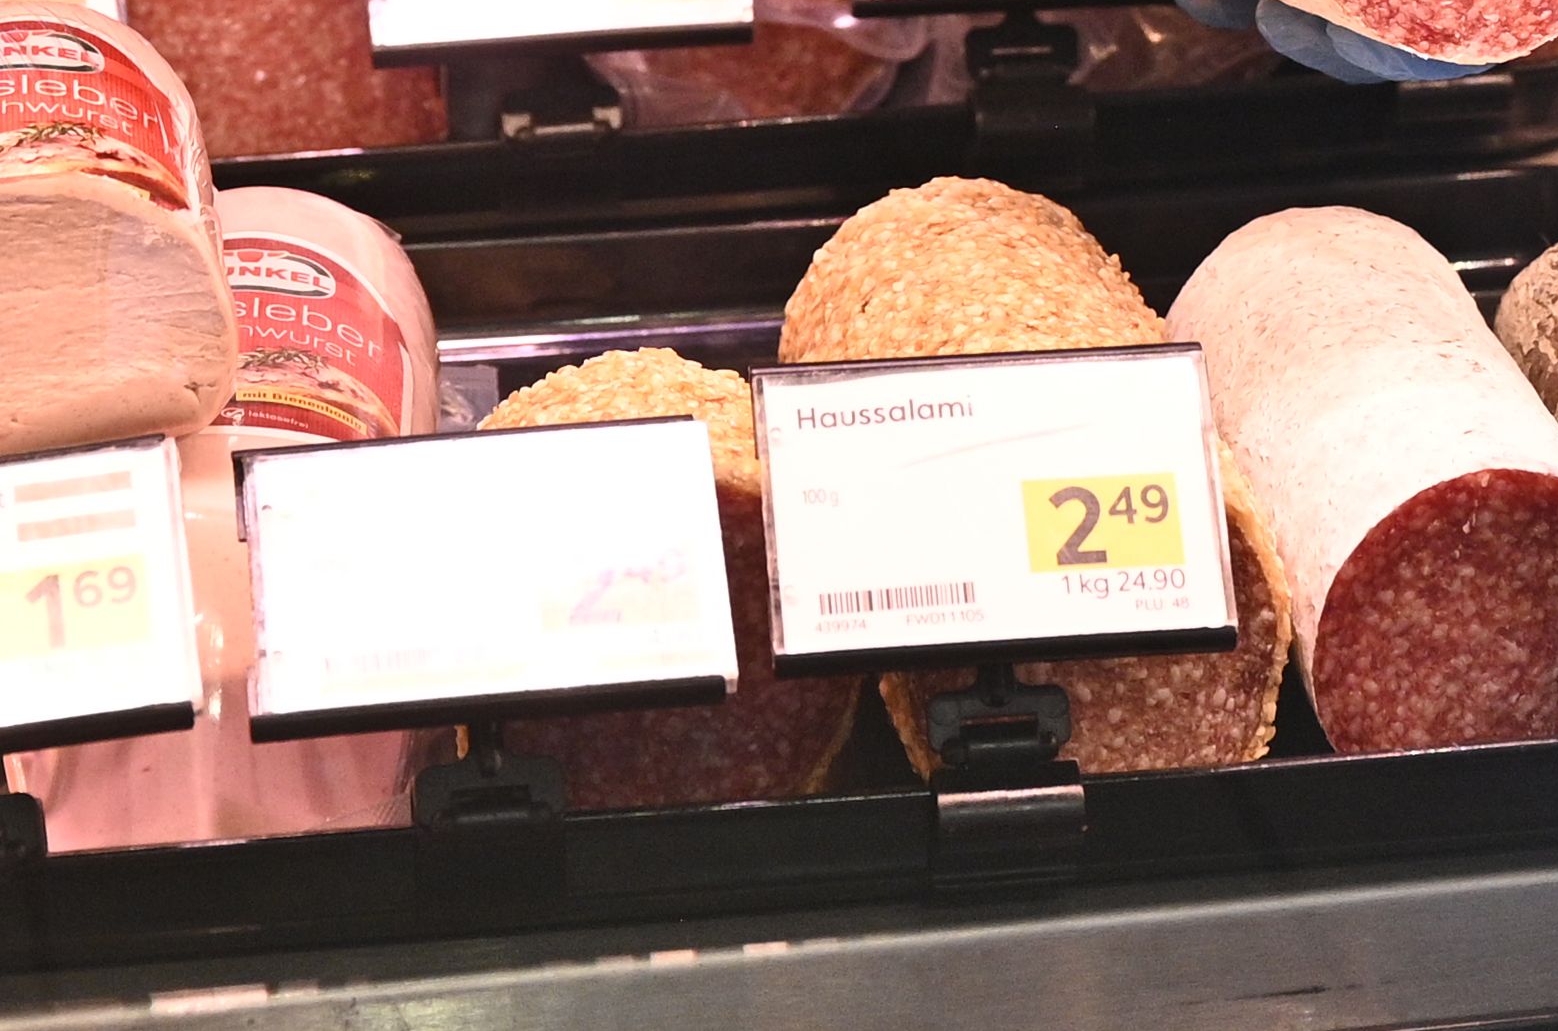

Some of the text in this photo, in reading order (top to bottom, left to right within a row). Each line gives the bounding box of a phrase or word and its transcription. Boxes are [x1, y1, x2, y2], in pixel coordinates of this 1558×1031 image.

[243, 391, 267, 399] mit
[797, 395, 974, 430] Haussalami
[802, 489, 826, 504] 100
[1080, 573, 1110, 599] kg
[1118, 568, 1186, 592] 24.90
